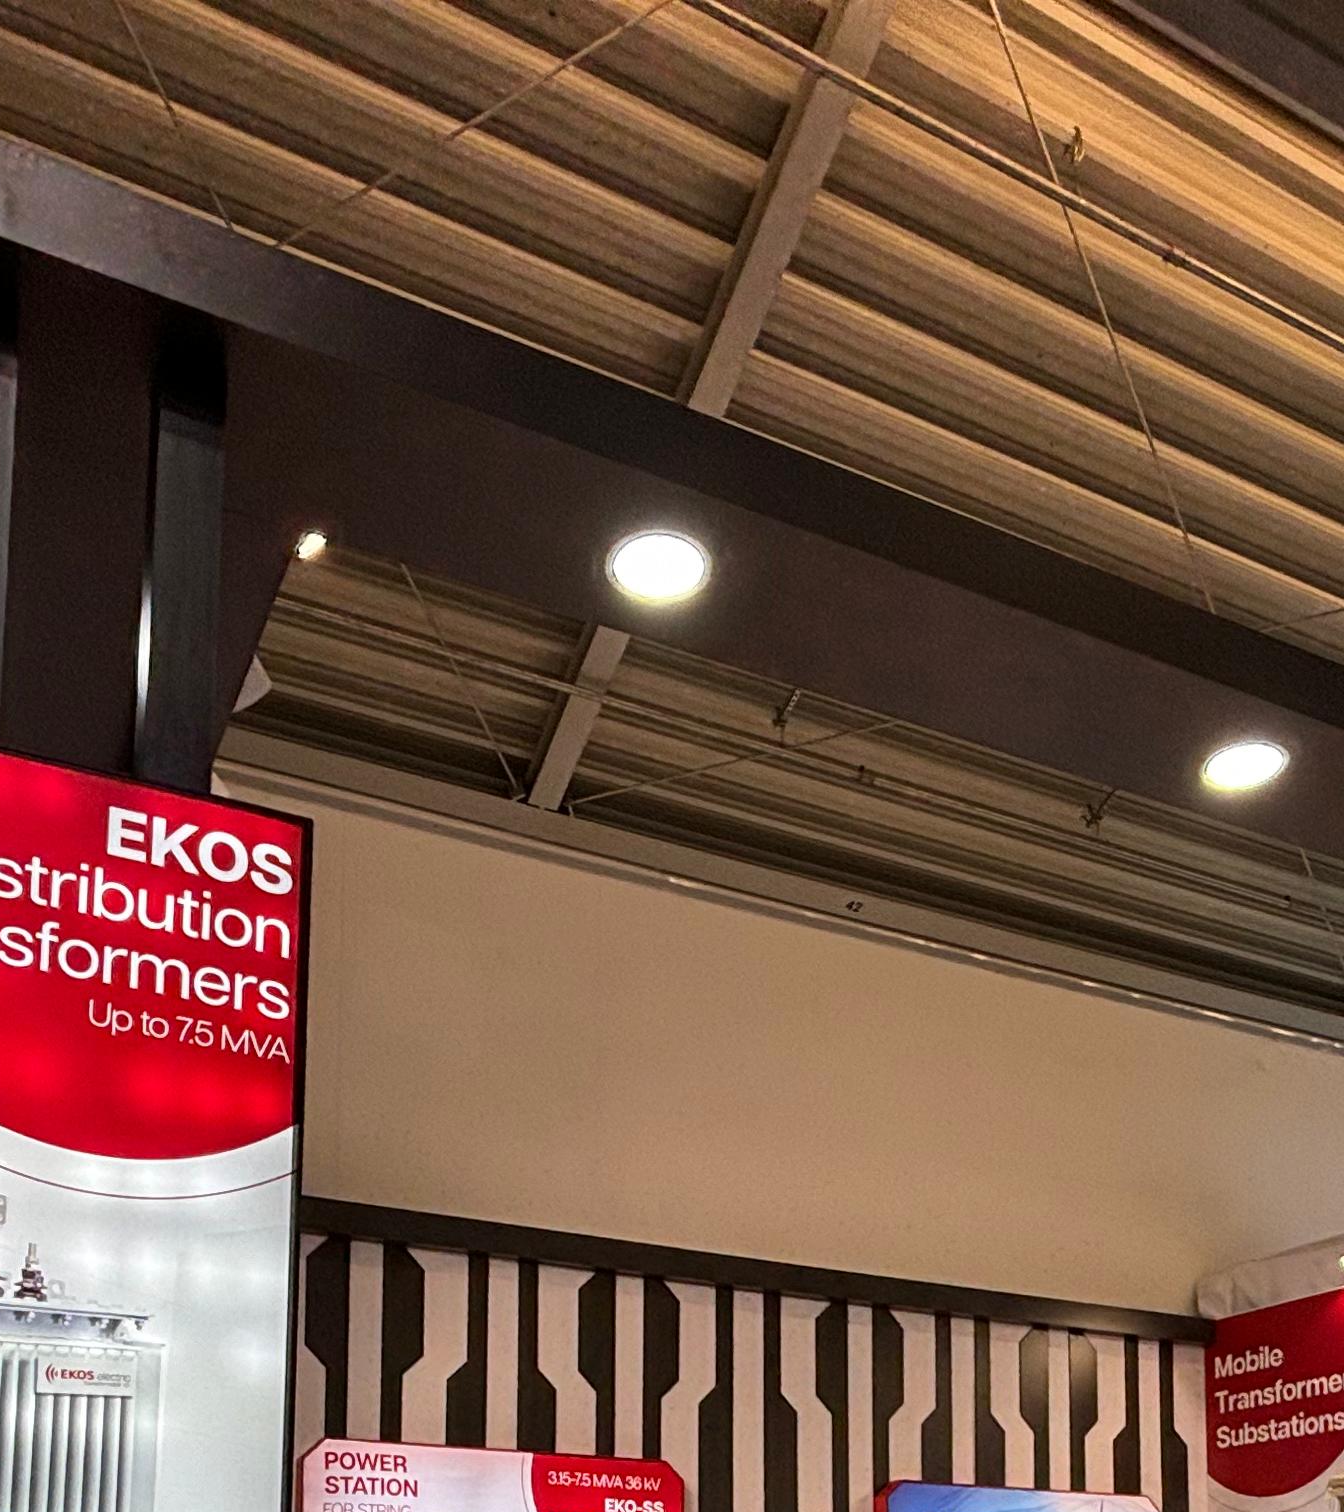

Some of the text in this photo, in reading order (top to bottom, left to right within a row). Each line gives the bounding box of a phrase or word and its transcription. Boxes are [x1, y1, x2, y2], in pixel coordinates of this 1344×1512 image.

[107, 806, 293, 894] EKOS
[89, 999, 290, 1064] Up to 7.5 MVA
[1214, 1346, 1284, 1379] Mobile
[61, 1369, 94, 1380] EKOS
[324, 1452, 407, 1473] POWER
[325, 1476, 418, 1497] STATION
[593, 1474, 623, 1489] MVA
[625, 1475, 642, 1490] 36
[644, 1477, 661, 1491] kV
